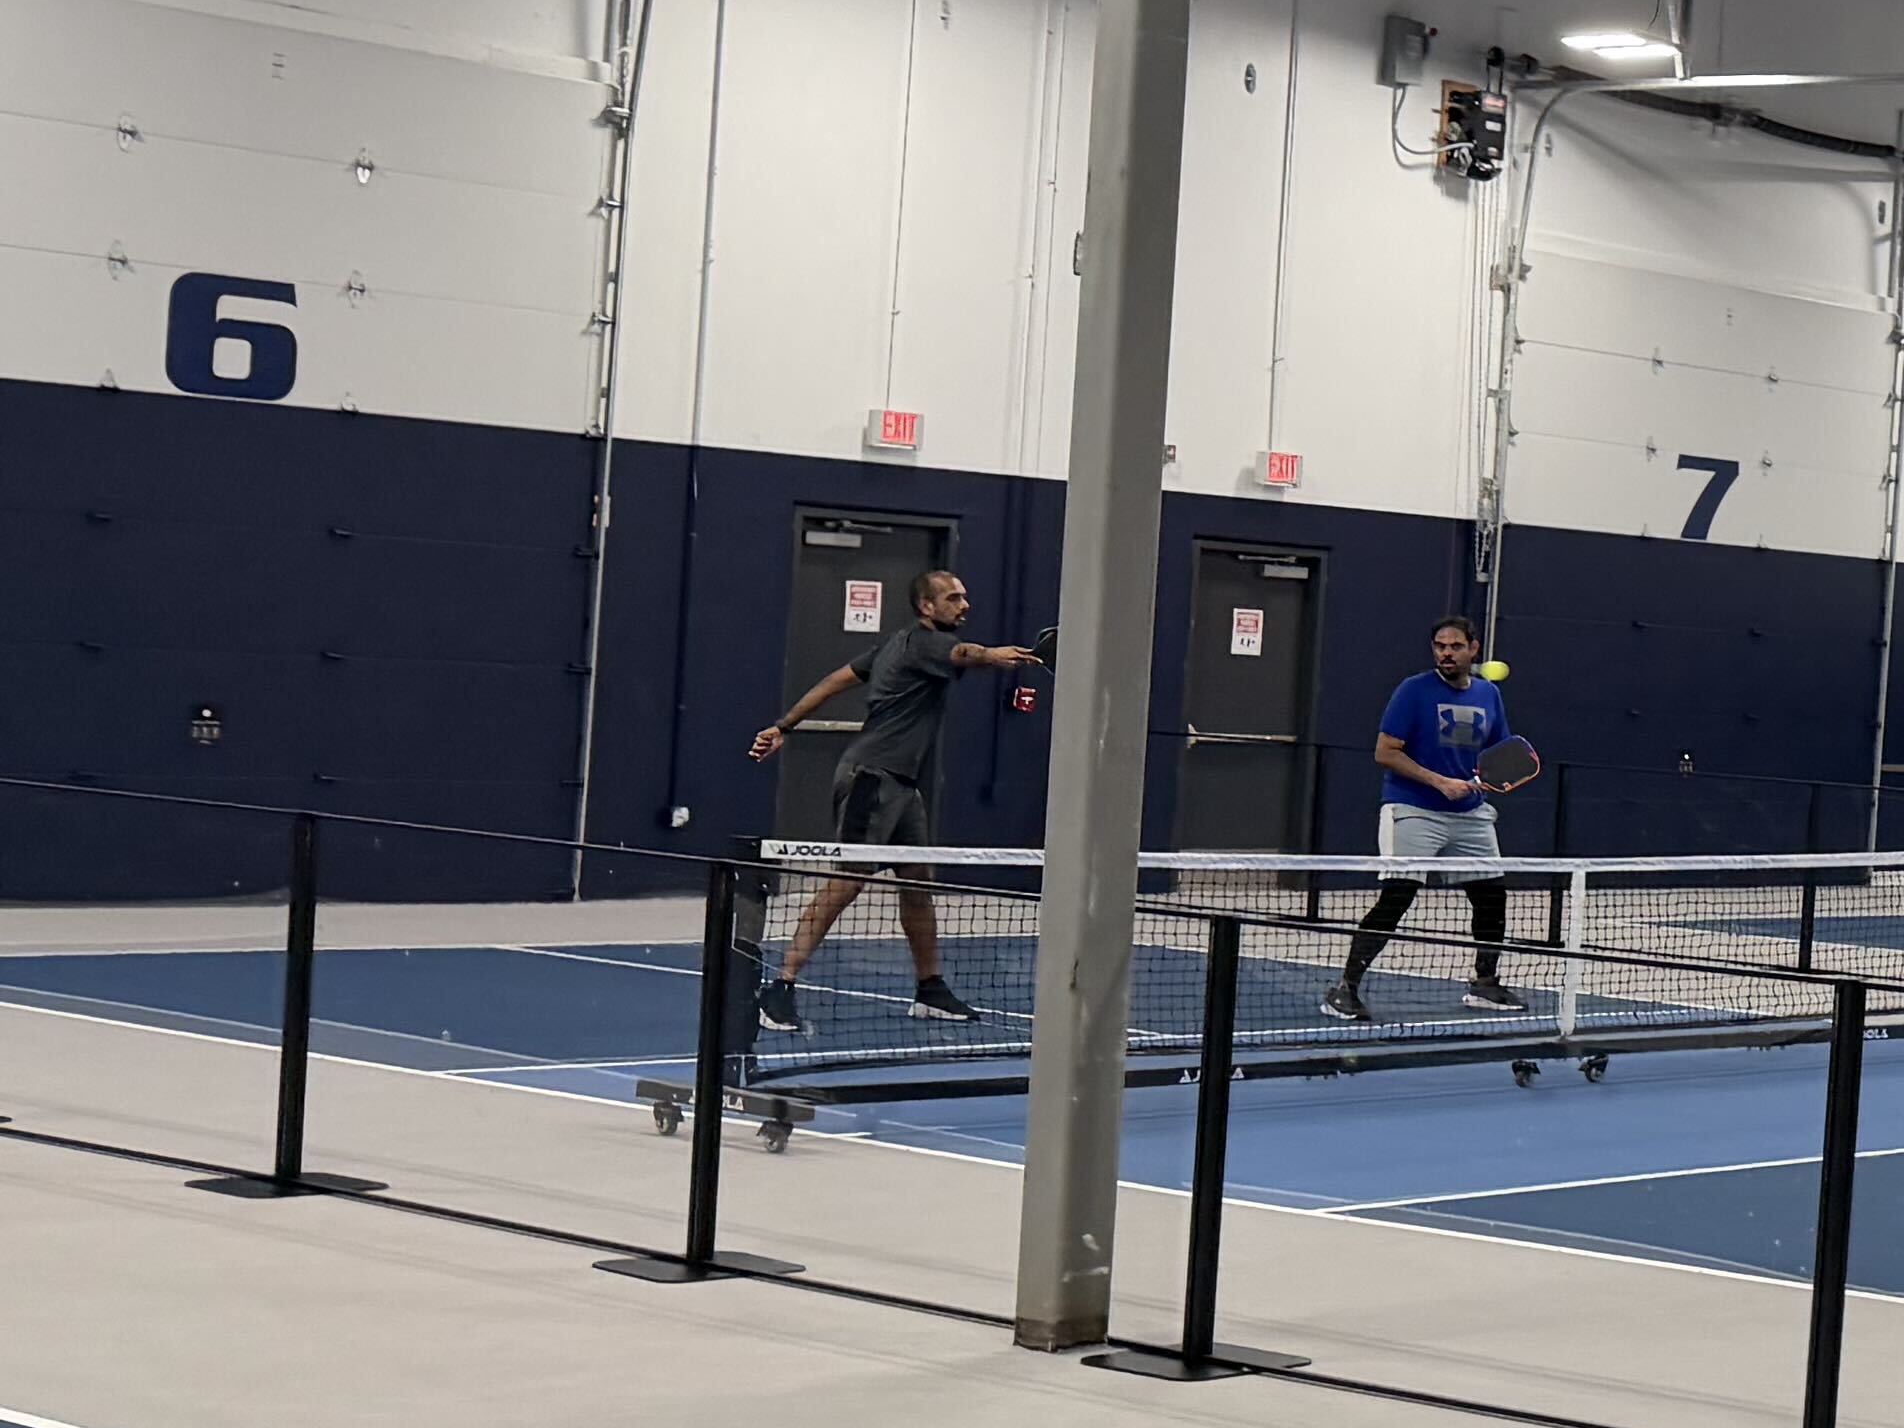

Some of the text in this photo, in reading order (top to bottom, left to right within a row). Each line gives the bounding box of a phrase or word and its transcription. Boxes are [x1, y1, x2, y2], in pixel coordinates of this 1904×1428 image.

[165, 272, 298, 401] 6
[881, 410, 918, 445] EXIT
[1677, 454, 1740, 540] 7
[790, 845, 841, 858] JOOLA
